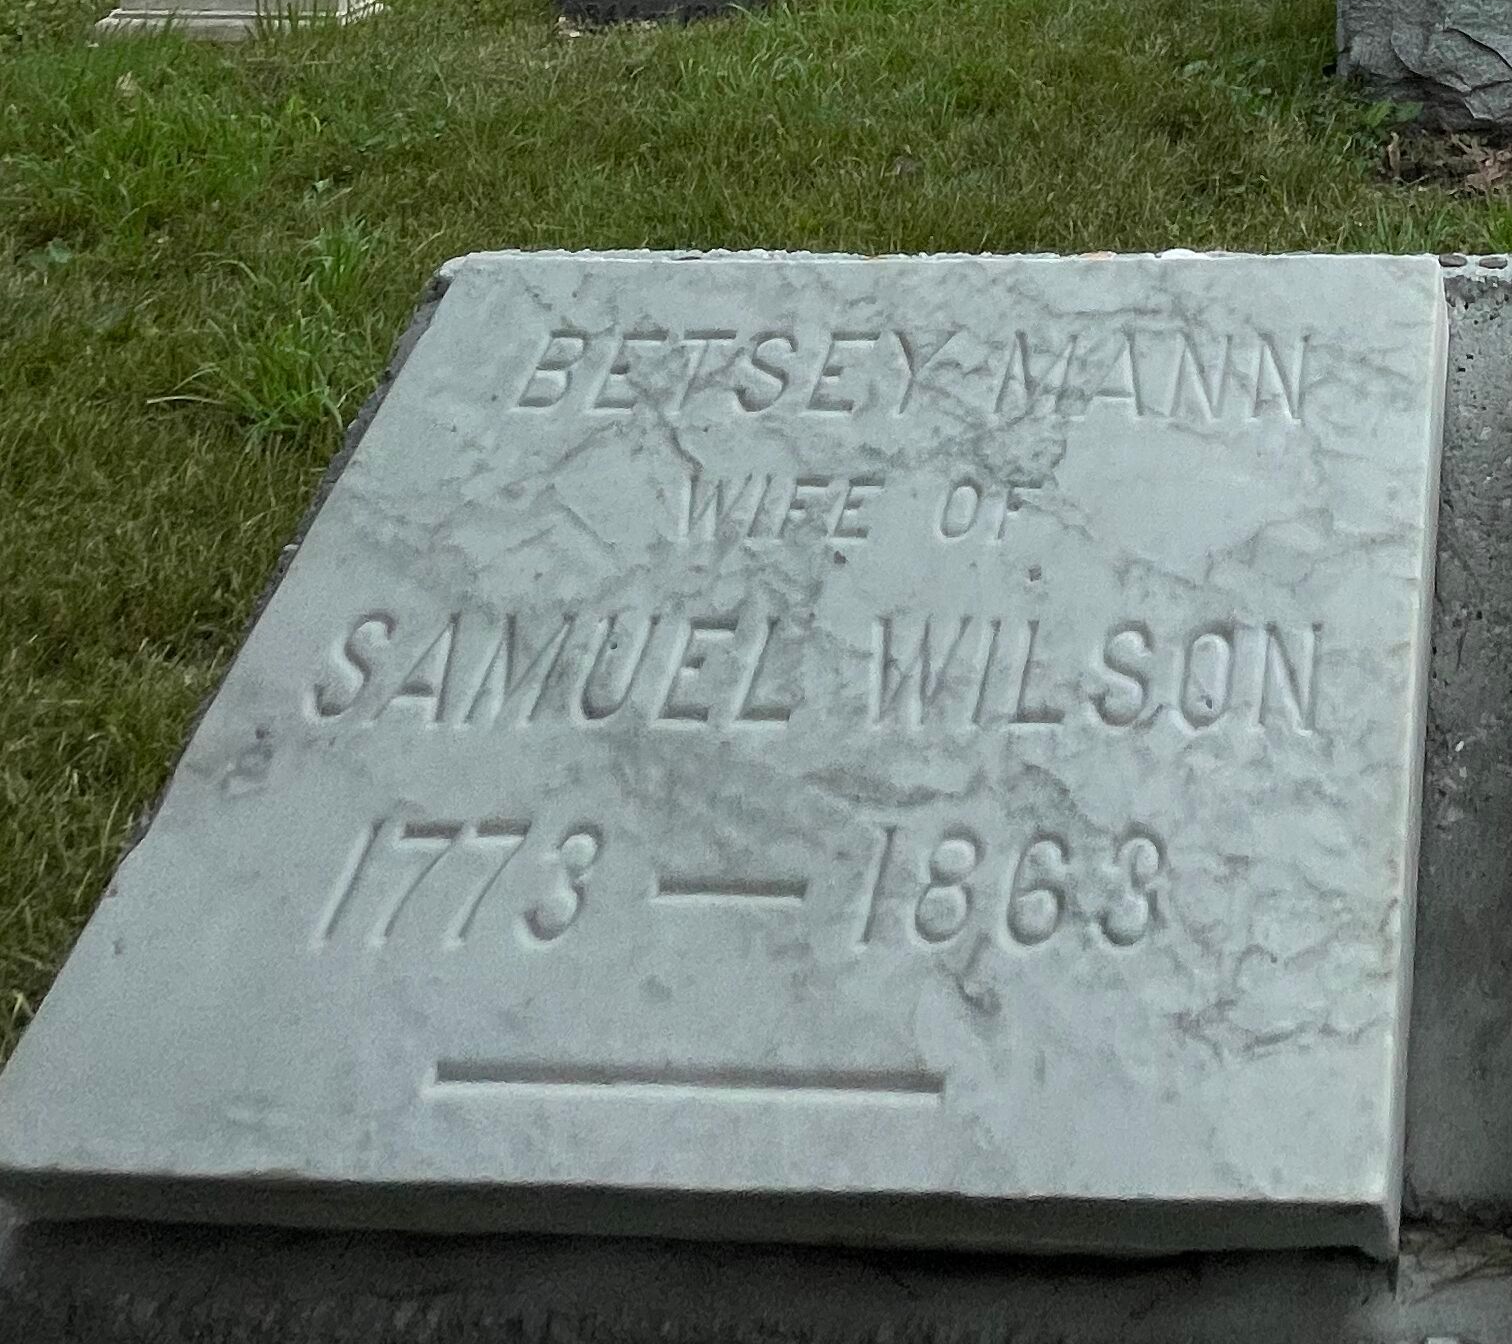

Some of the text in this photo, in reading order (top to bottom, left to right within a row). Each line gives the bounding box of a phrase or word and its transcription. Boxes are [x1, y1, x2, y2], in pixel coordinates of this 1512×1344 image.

[513, 325, 1316, 426] BETSEY MANN
[676, 471, 1044, 543] WIFE OF
[310, 609, 1328, 738] SAMUEL WILSON
[308, 816, 606, 952] 1773
[853, 820, 1174, 954] 1863
